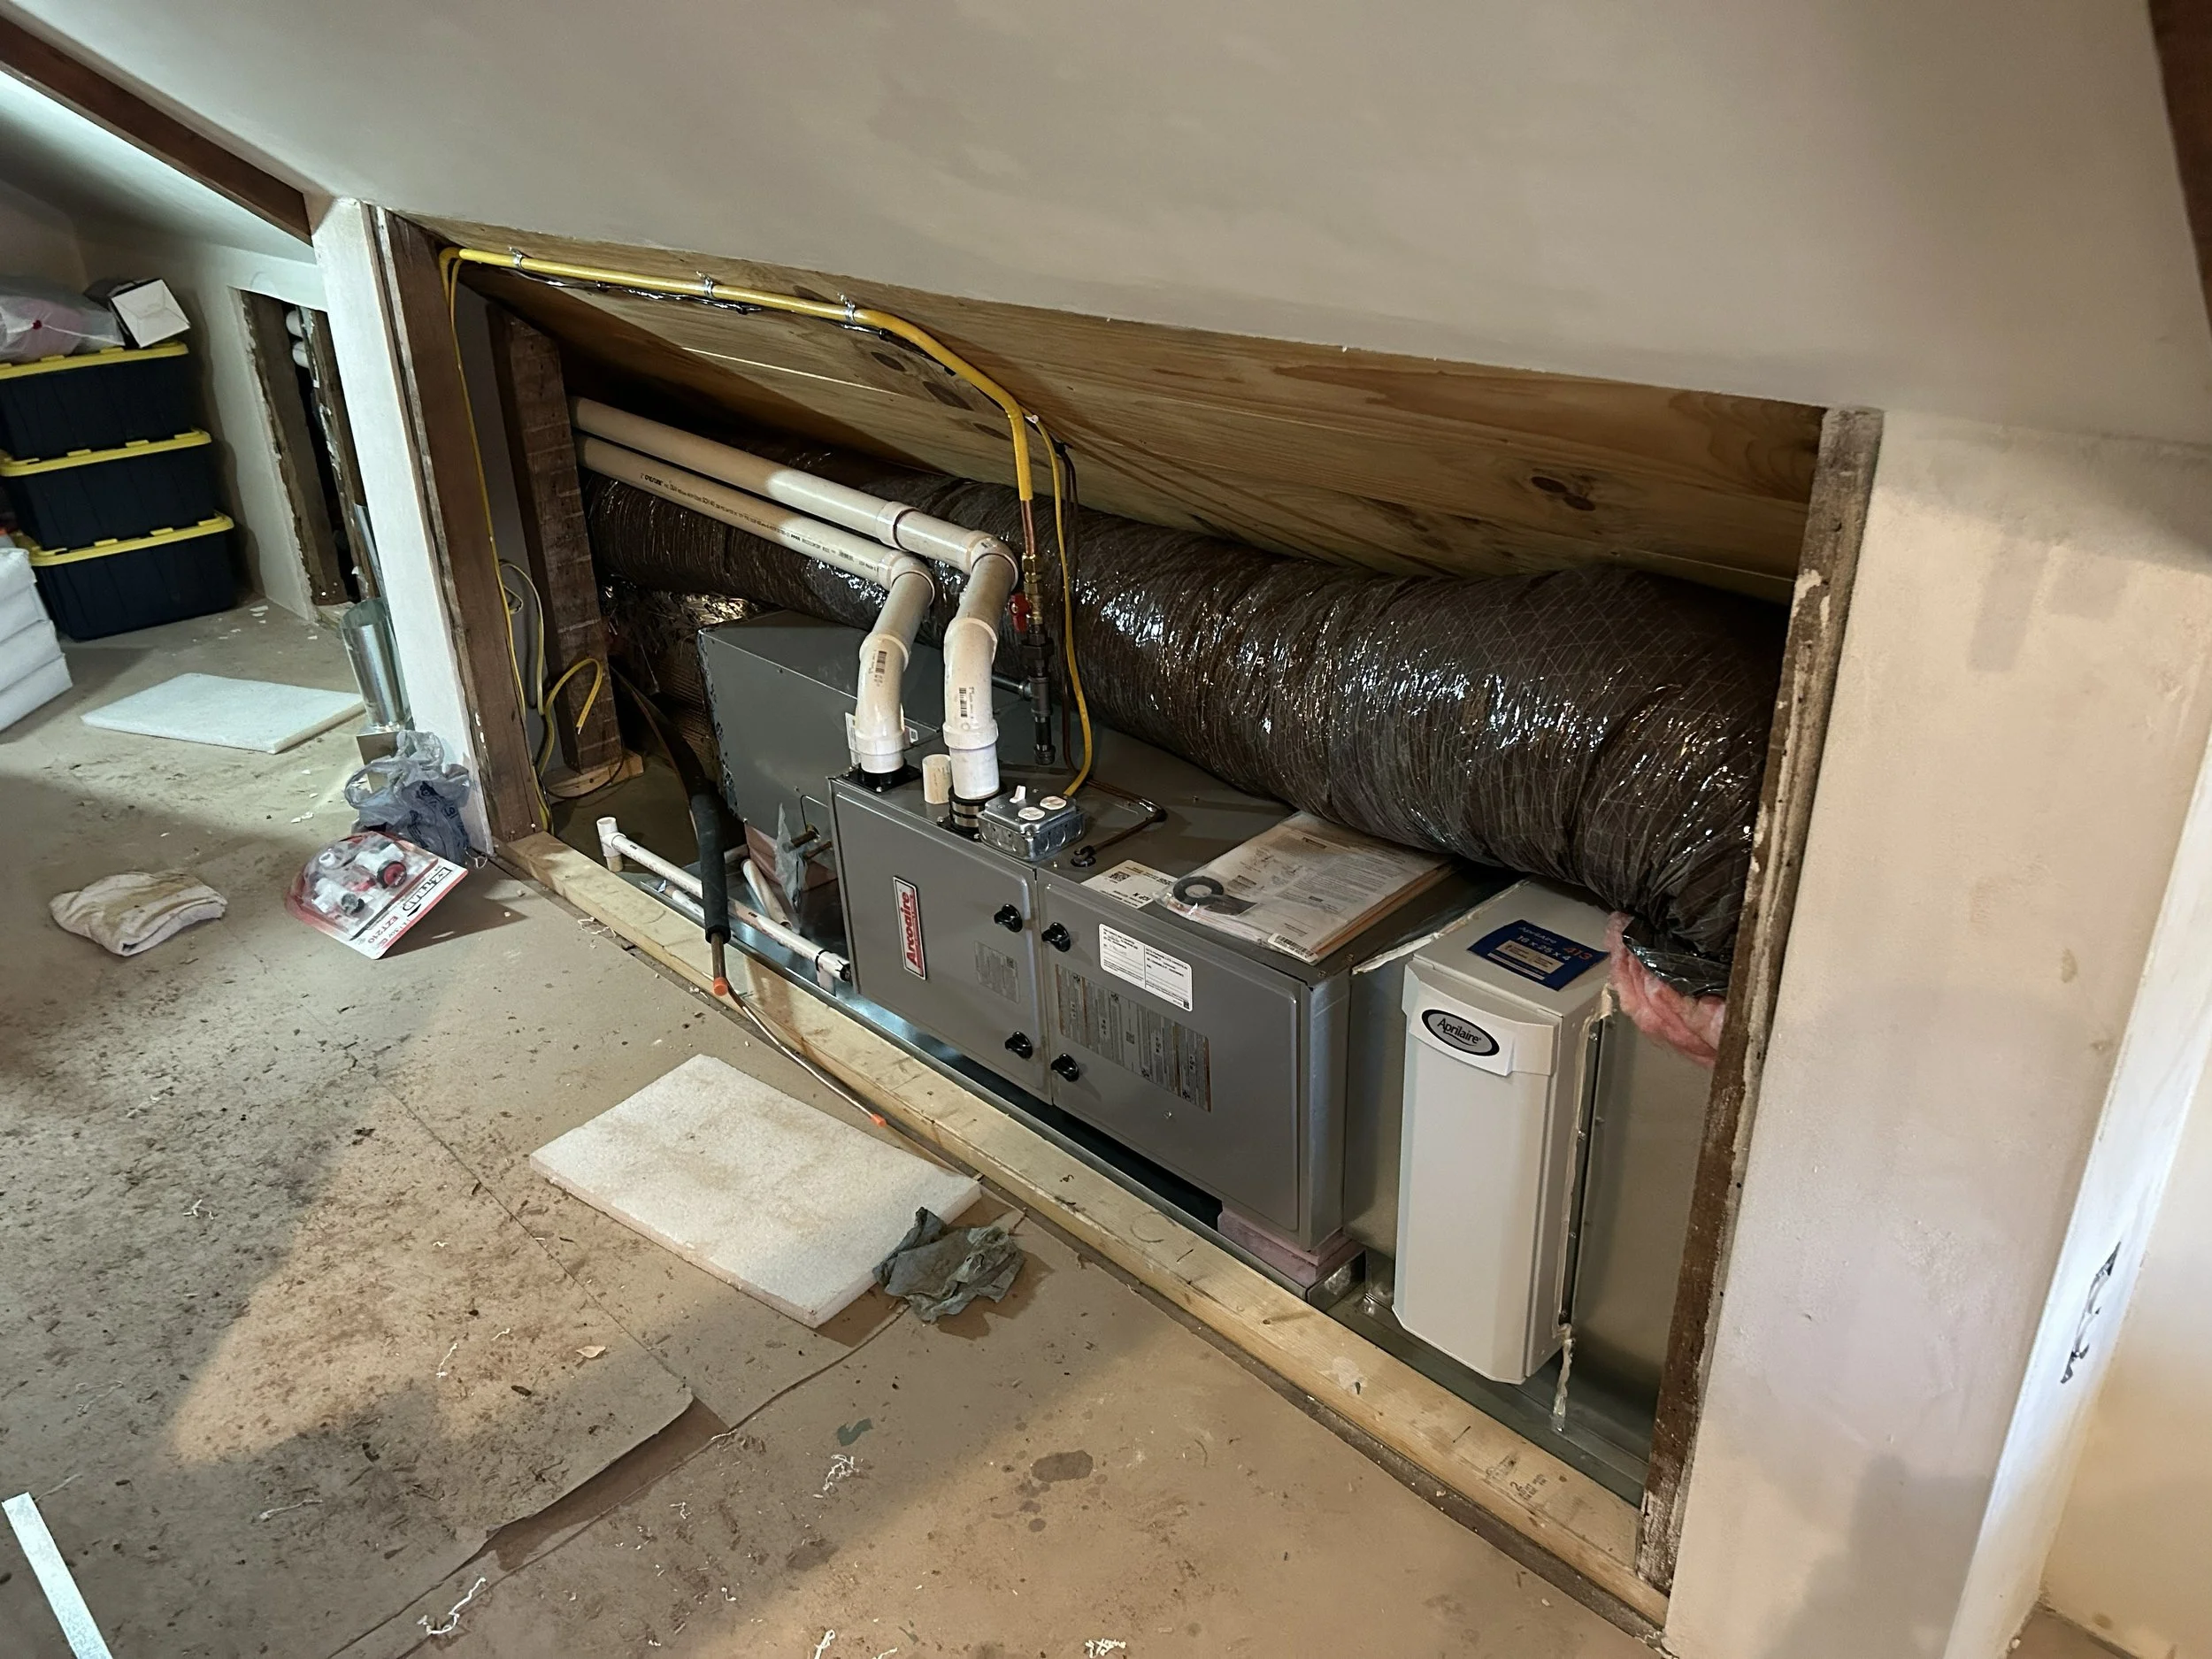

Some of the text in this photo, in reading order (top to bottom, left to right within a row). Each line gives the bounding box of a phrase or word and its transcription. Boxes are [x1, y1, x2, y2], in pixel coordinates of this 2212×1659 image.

[368, 916, 398, 944] EZT210
[900, 891, 918, 967] Arcoaire
[1517, 934, 1529, 944] 16
[1538, 943, 1553, 954] 25
[1563, 946, 1594, 961] 413
[1437, 1018, 1481, 1044] Aprilaire
